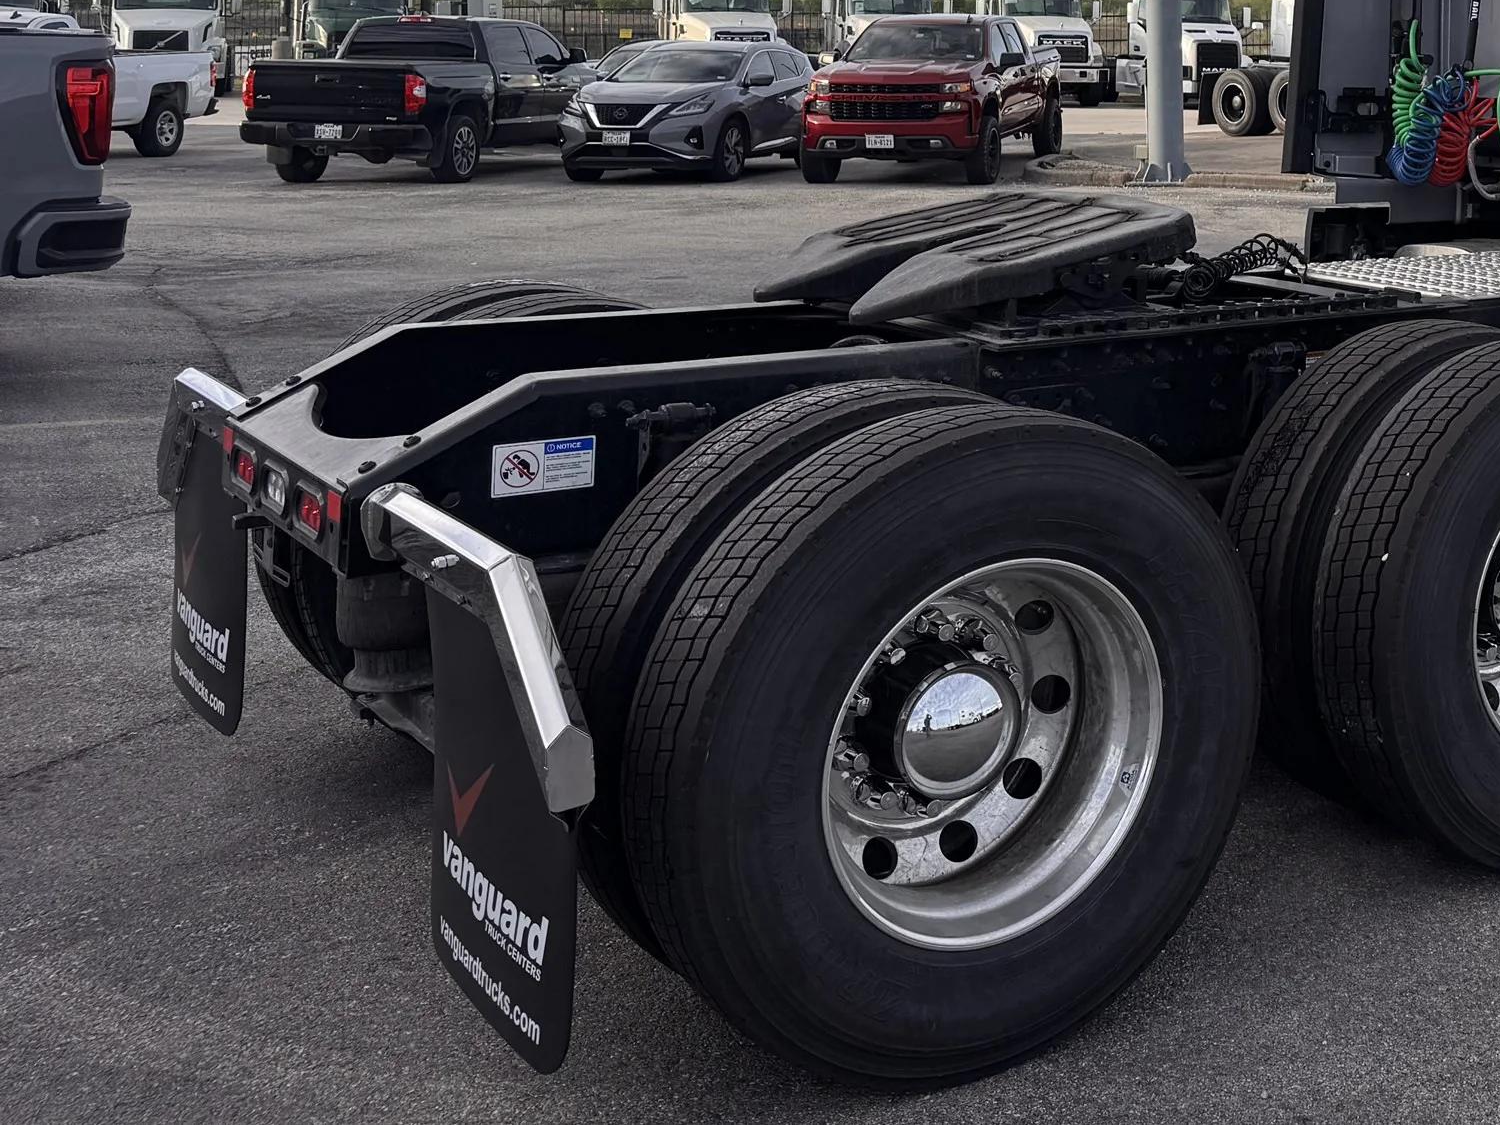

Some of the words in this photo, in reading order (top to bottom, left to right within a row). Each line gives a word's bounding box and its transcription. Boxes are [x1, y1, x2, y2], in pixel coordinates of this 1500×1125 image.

[556, 441, 582, 450] NOTICE
[177, 587, 230, 663] vanguard
[206, 652, 226, 674] CENTERS
[443, 830, 550, 966] vanguard
[440, 915, 540, 1045] vanguardtrucks.com
[484, 919, 507, 951] TRUCK
[507, 944, 542, 982] CENTERS
